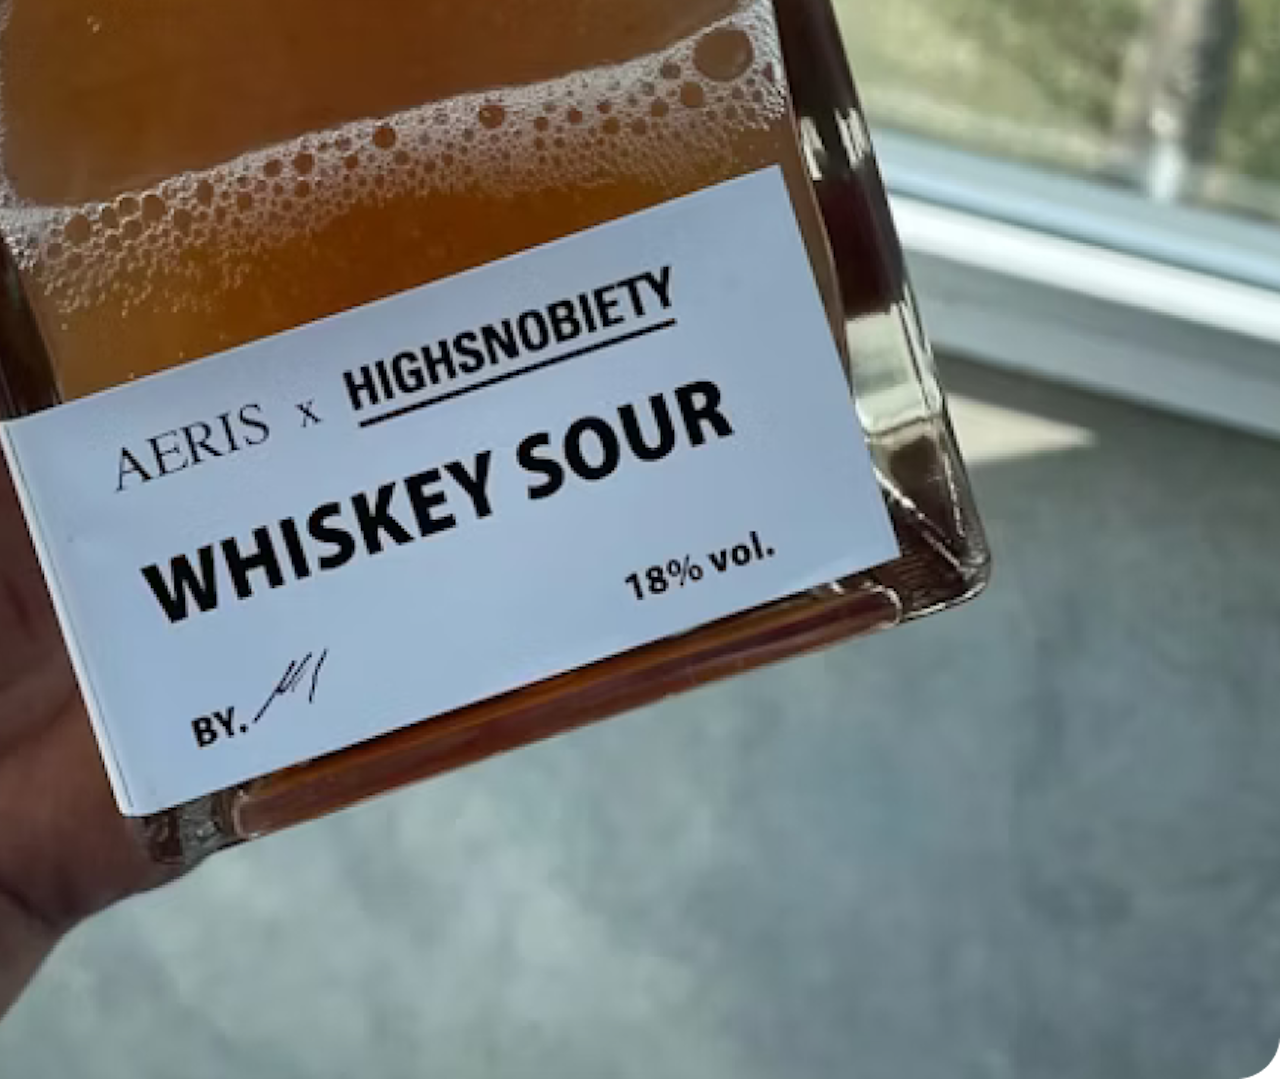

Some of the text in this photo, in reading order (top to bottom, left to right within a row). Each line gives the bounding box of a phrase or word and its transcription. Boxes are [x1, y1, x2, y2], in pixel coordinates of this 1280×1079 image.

[114, 264, 674, 493] AERIS x HIGHSNOBIETY
[140, 379, 734, 625] WHISKEY SOUR
[624, 529, 777, 602] 18% vol.
[190, 706, 250, 749] BY.
